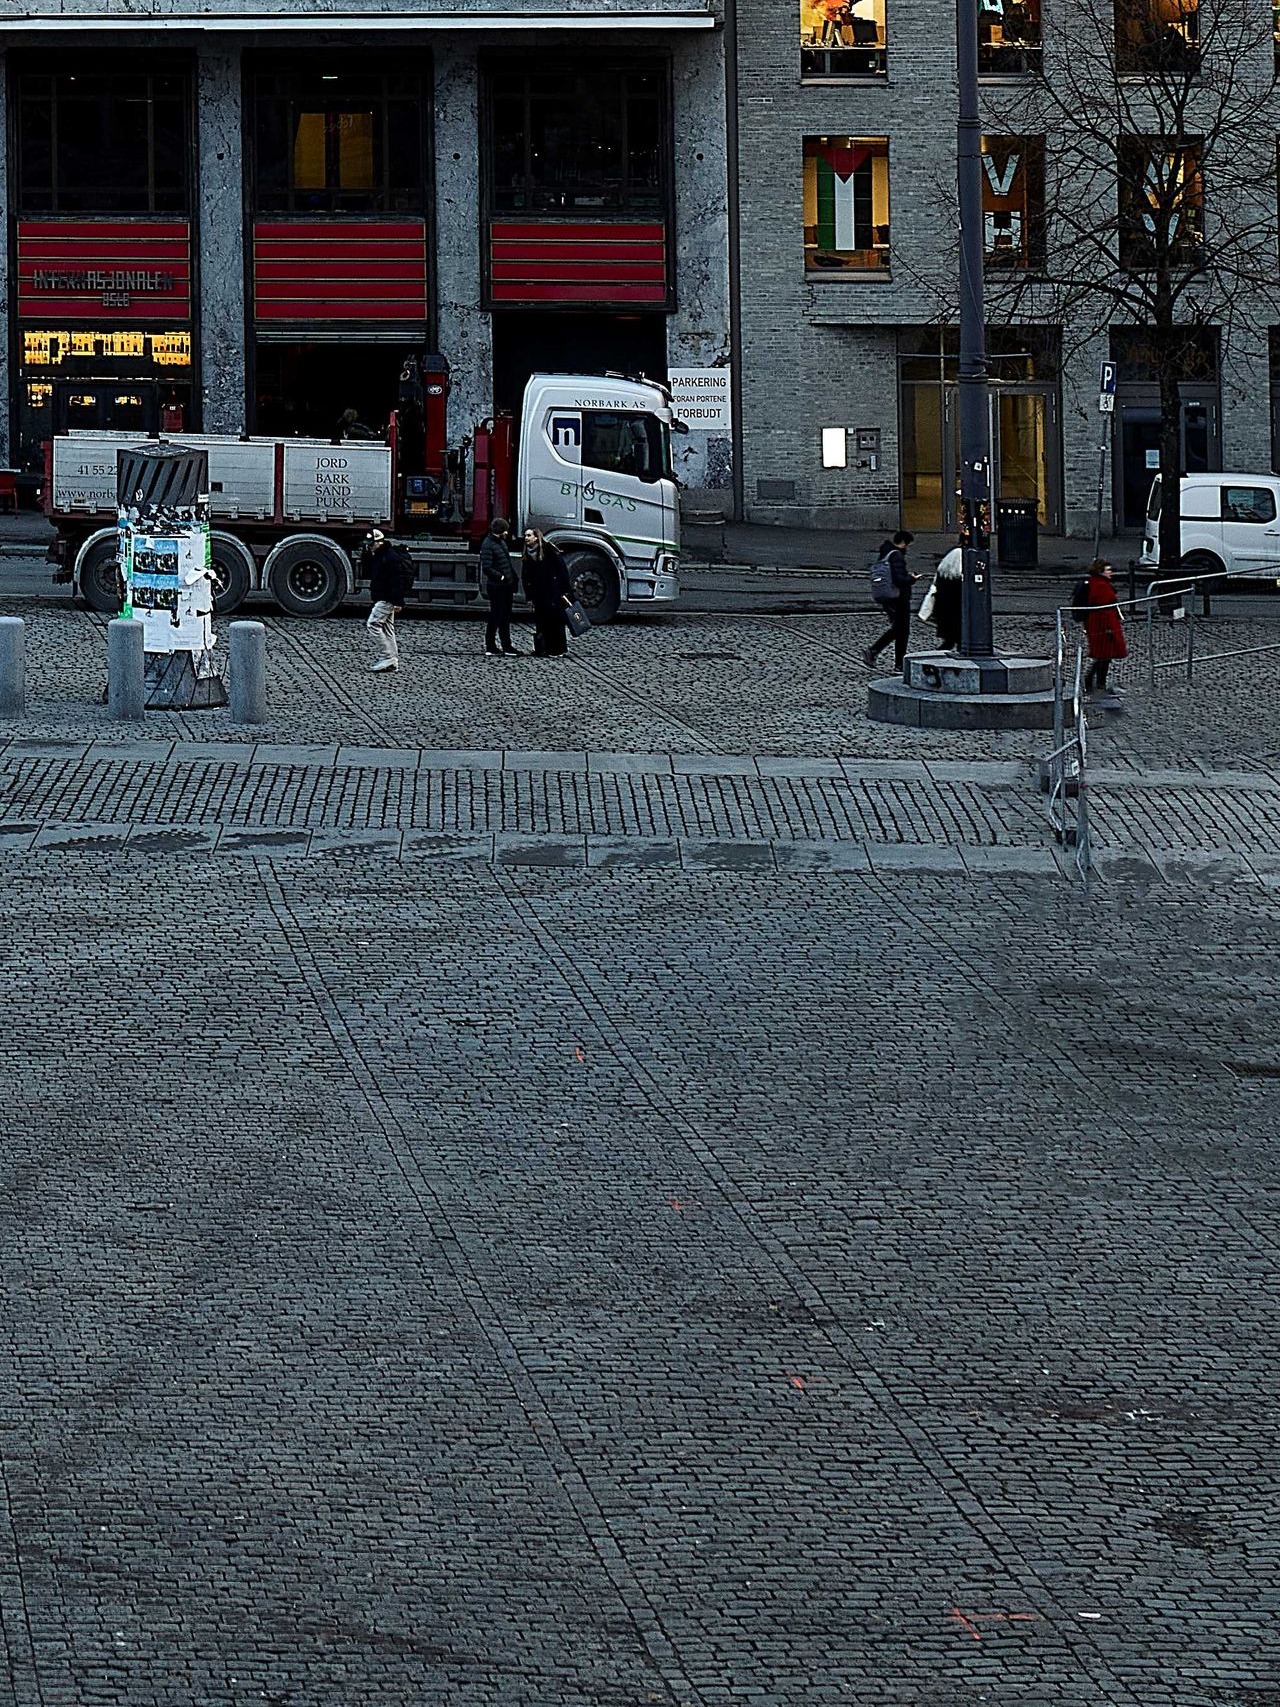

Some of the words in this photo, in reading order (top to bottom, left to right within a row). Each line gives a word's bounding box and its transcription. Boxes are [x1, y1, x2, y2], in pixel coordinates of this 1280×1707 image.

[672, 377, 727, 387] PARKERING
[1104, 366, 1113, 390] P
[574, 399, 628, 409] NORBARK
[632, 400, 646, 409] AS
[696, 395, 727, 403] PORTENE
[677, 408, 722, 419] FORBUDT
[316, 457, 348, 469] JORD
[77, 465, 89, 475] 41
[92, 465, 105, 475] 55
[316, 473, 349, 484] BARK
[58, 489, 117, 499] www.norb
[315, 485, 351, 496] SAND
[316, 497, 351, 508] PUKK
